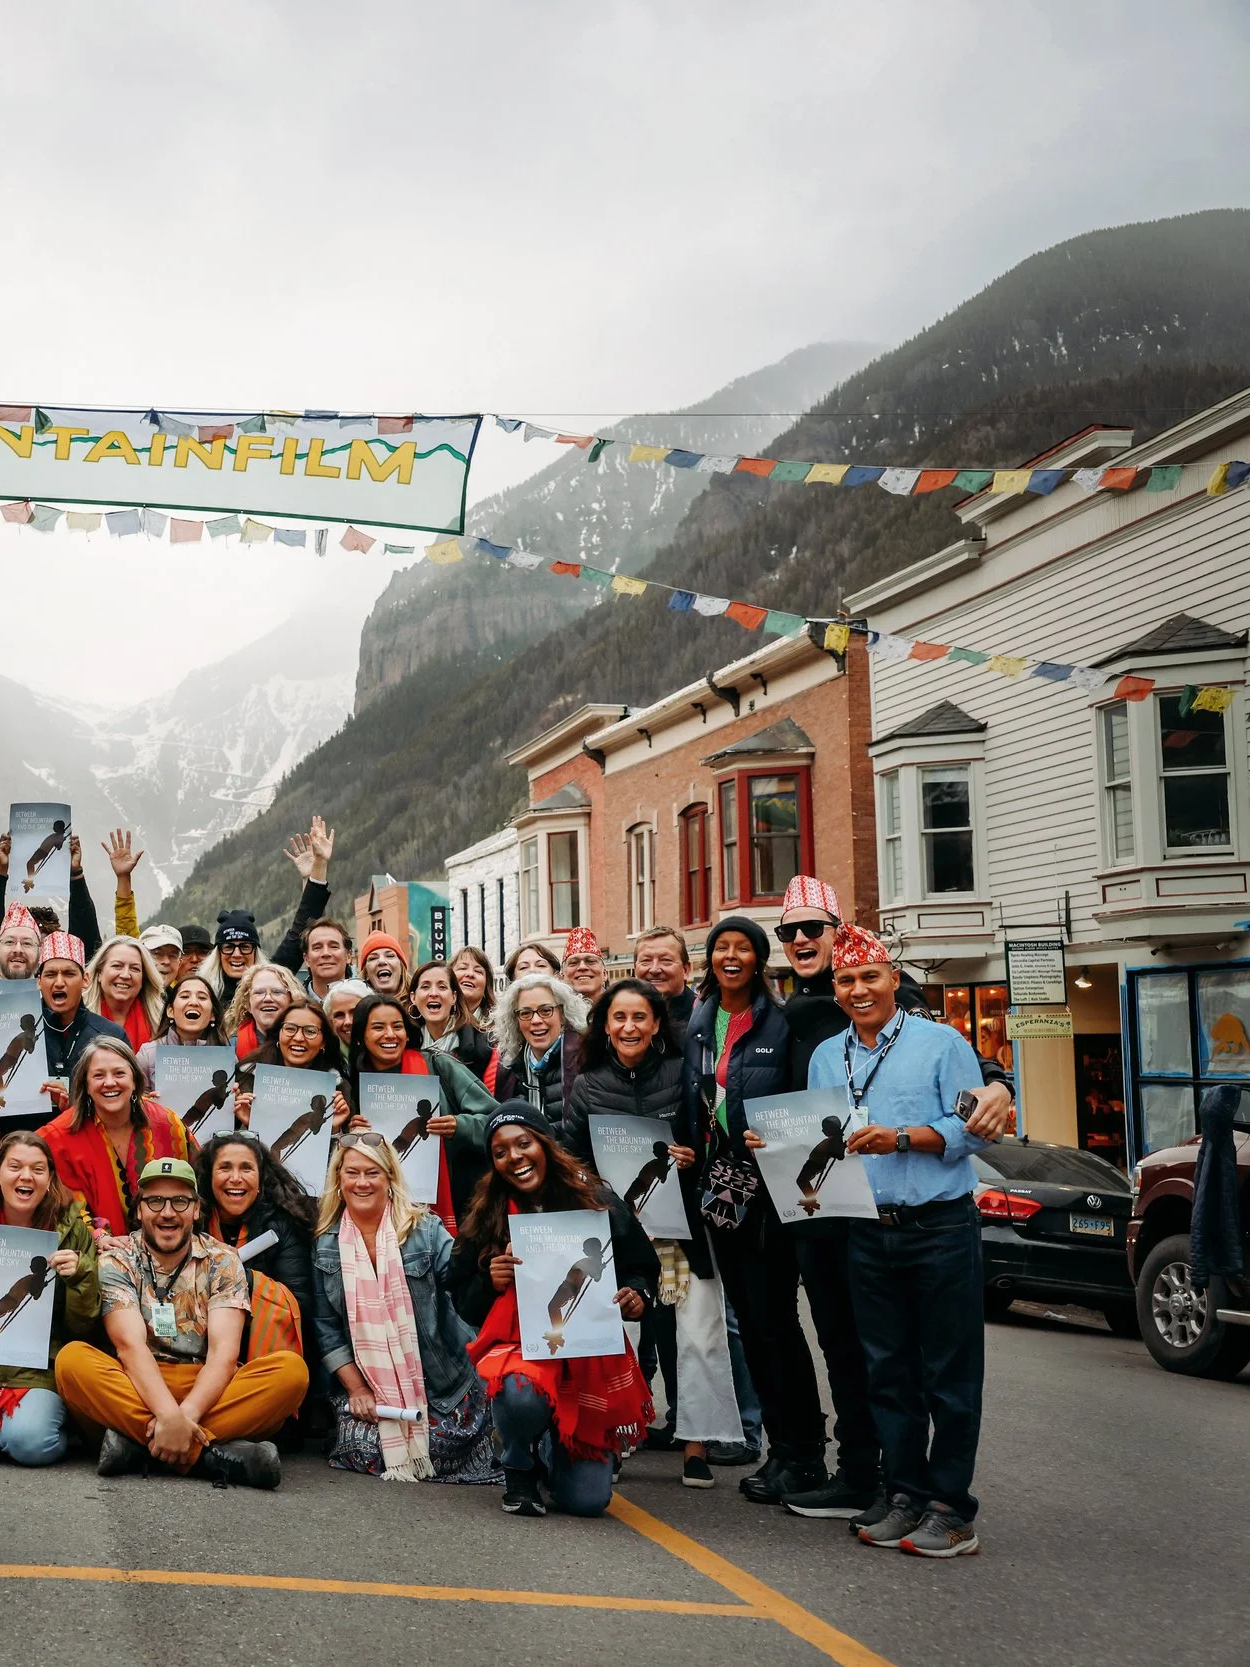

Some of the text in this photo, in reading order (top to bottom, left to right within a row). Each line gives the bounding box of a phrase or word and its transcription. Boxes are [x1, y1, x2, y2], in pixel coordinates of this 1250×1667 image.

[0, 1021, 10, 1029] SKY
[1016, 1019, 1064, 1028] ESPERANZA'S
[163, 1057, 190, 1065] BETWEEN
[170, 1066, 212, 1074] THE MOUNTAIN
[164, 1074, 178, 1082] AND
[179, 1074, 190, 1082] THE
[262, 1076, 290, 1086] BETWEEN
[270, 1085, 313, 1096] THE MOUNTAIN
[367, 1085, 394, 1093] BETWEEN
[264, 1094, 301, 1104] AND THE SKY
[374, 1093, 418, 1102] THE MOUNTAIN
[396, 1103, 408, 1111] SKY
[755, 1108, 789, 1121] BETWEEN
[766, 1114, 820, 1130] THE MOUNTAIN
[598, 1127, 627, 1136] BETWEEN
[764, 1126, 809, 1139] AND THE SKY
[606, 1136, 652, 1145] THE MOUNTAIN
[617, 1145, 628, 1153] THE
[630, 1145, 642, 1153] SKY
[520, 1226, 552, 1235] BETWEEN
[530, 1234, 582, 1243] THE MOUNTAIN
[526, 1243, 570, 1253] AND THE SKY
[7, 1258, 19, 1266] SKY
